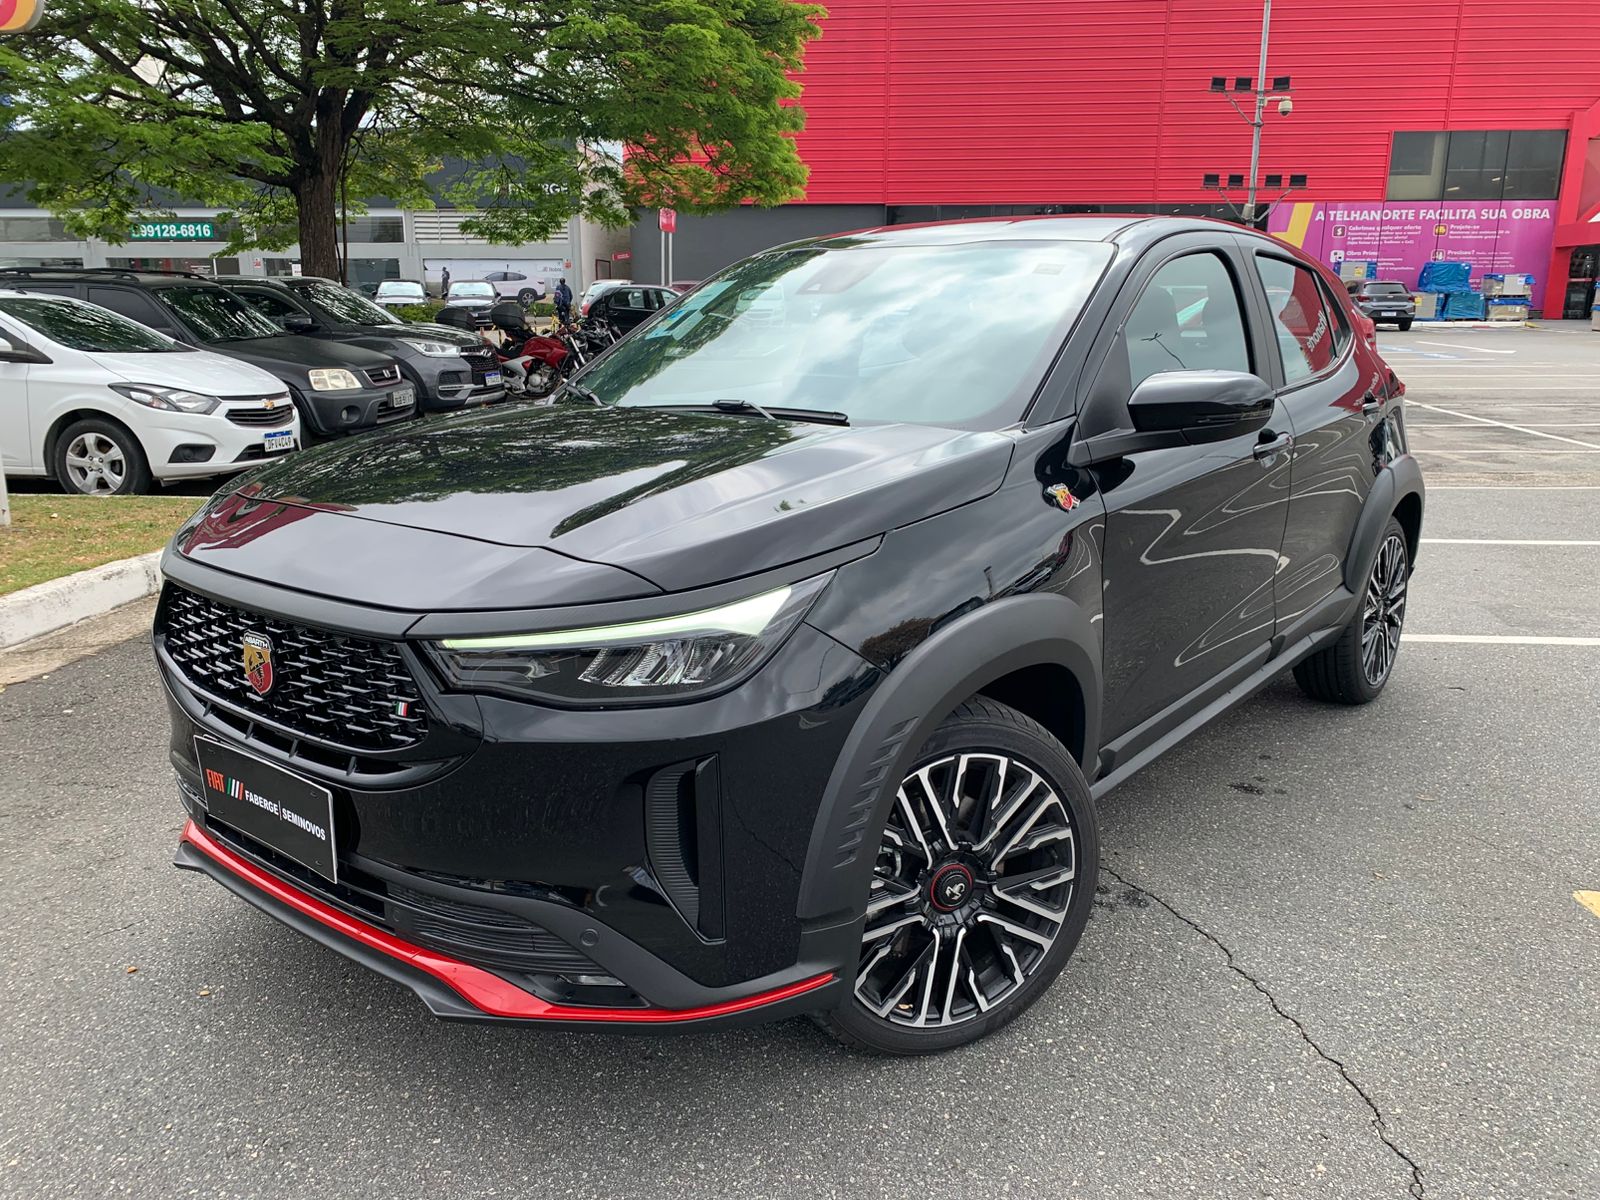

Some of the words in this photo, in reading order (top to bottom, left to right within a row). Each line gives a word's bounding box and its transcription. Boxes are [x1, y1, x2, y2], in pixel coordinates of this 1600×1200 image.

[1315, 210, 1325, 221] A
[1329, 210, 1415, 221] TELHANORTE
[1419, 209, 1476, 221] FACILITA
[1480, 208, 1508, 220] SUA
[1511, 208, 1550, 220] OBRA
[245, 636, 268, 649] ABARTH
[206, 768, 225, 793] FIAT
[245, 790, 279, 815] FABERGE
[282, 807, 326, 841] SEMINOVOS
